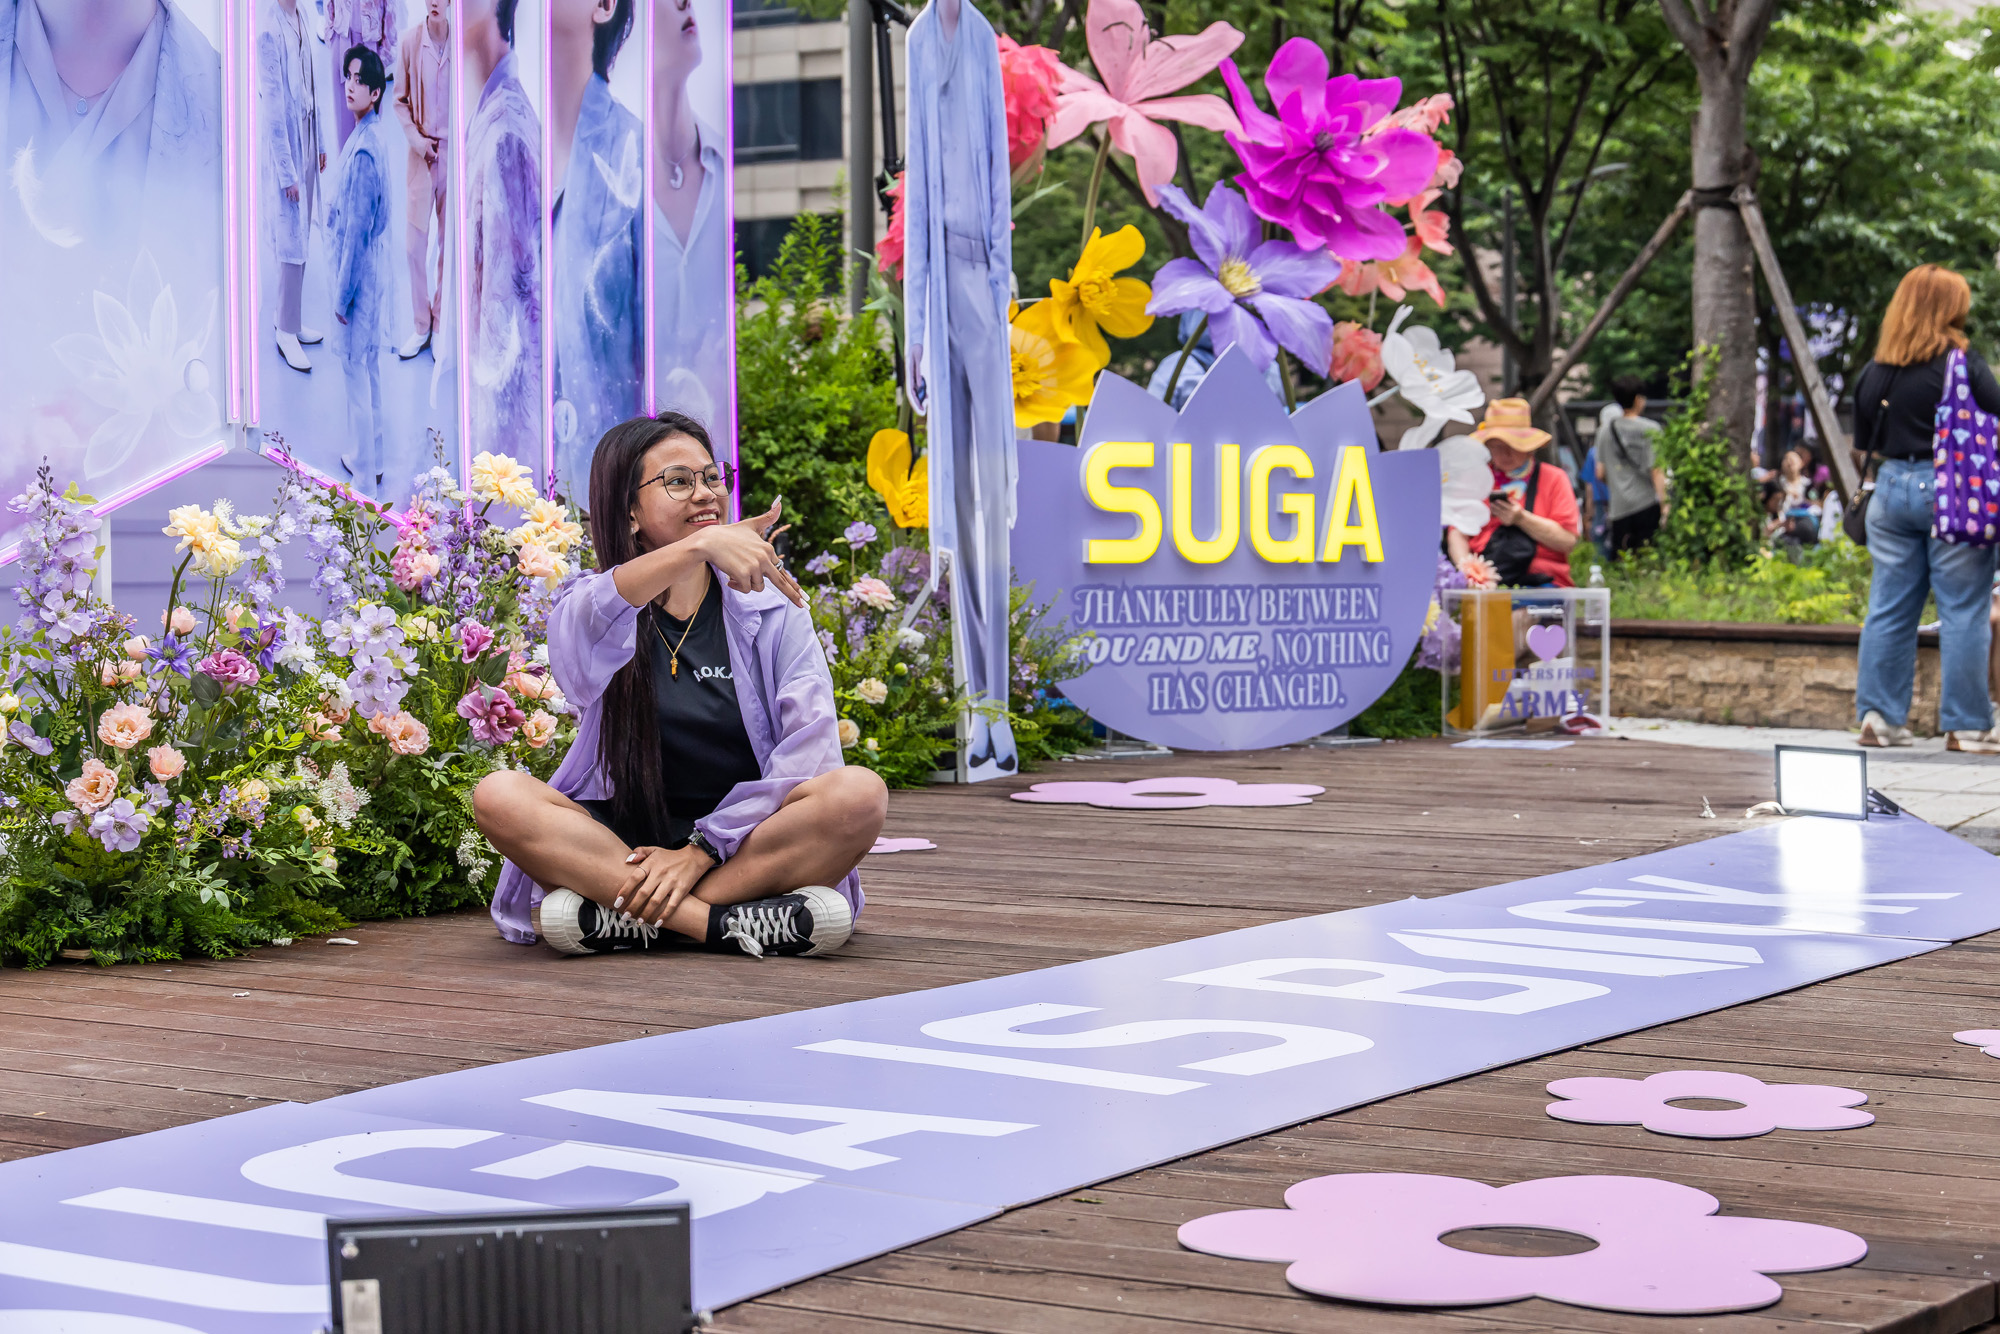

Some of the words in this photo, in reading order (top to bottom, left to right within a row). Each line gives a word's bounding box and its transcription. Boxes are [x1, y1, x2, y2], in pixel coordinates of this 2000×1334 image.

[1080, 441, 1385, 565] SUGA
[1074, 587, 1251, 625] THANKFULLY
[1260, 586, 1381, 623] BETWEEN
[1137, 635, 1206, 664] AND
[1209, 635, 1267, 667] ME,
[1274, 631, 1390, 667] NOTHING
[1151, 675, 1206, 711] HAS
[1214, 672, 1346, 710] CHANGED.
[1492, 667, 1554, 682] LETTERS
[1557, 667, 1596, 682] FROM
[1498, 688, 1592, 719] ARMY
[793, 1001, 1375, 1096] IS
